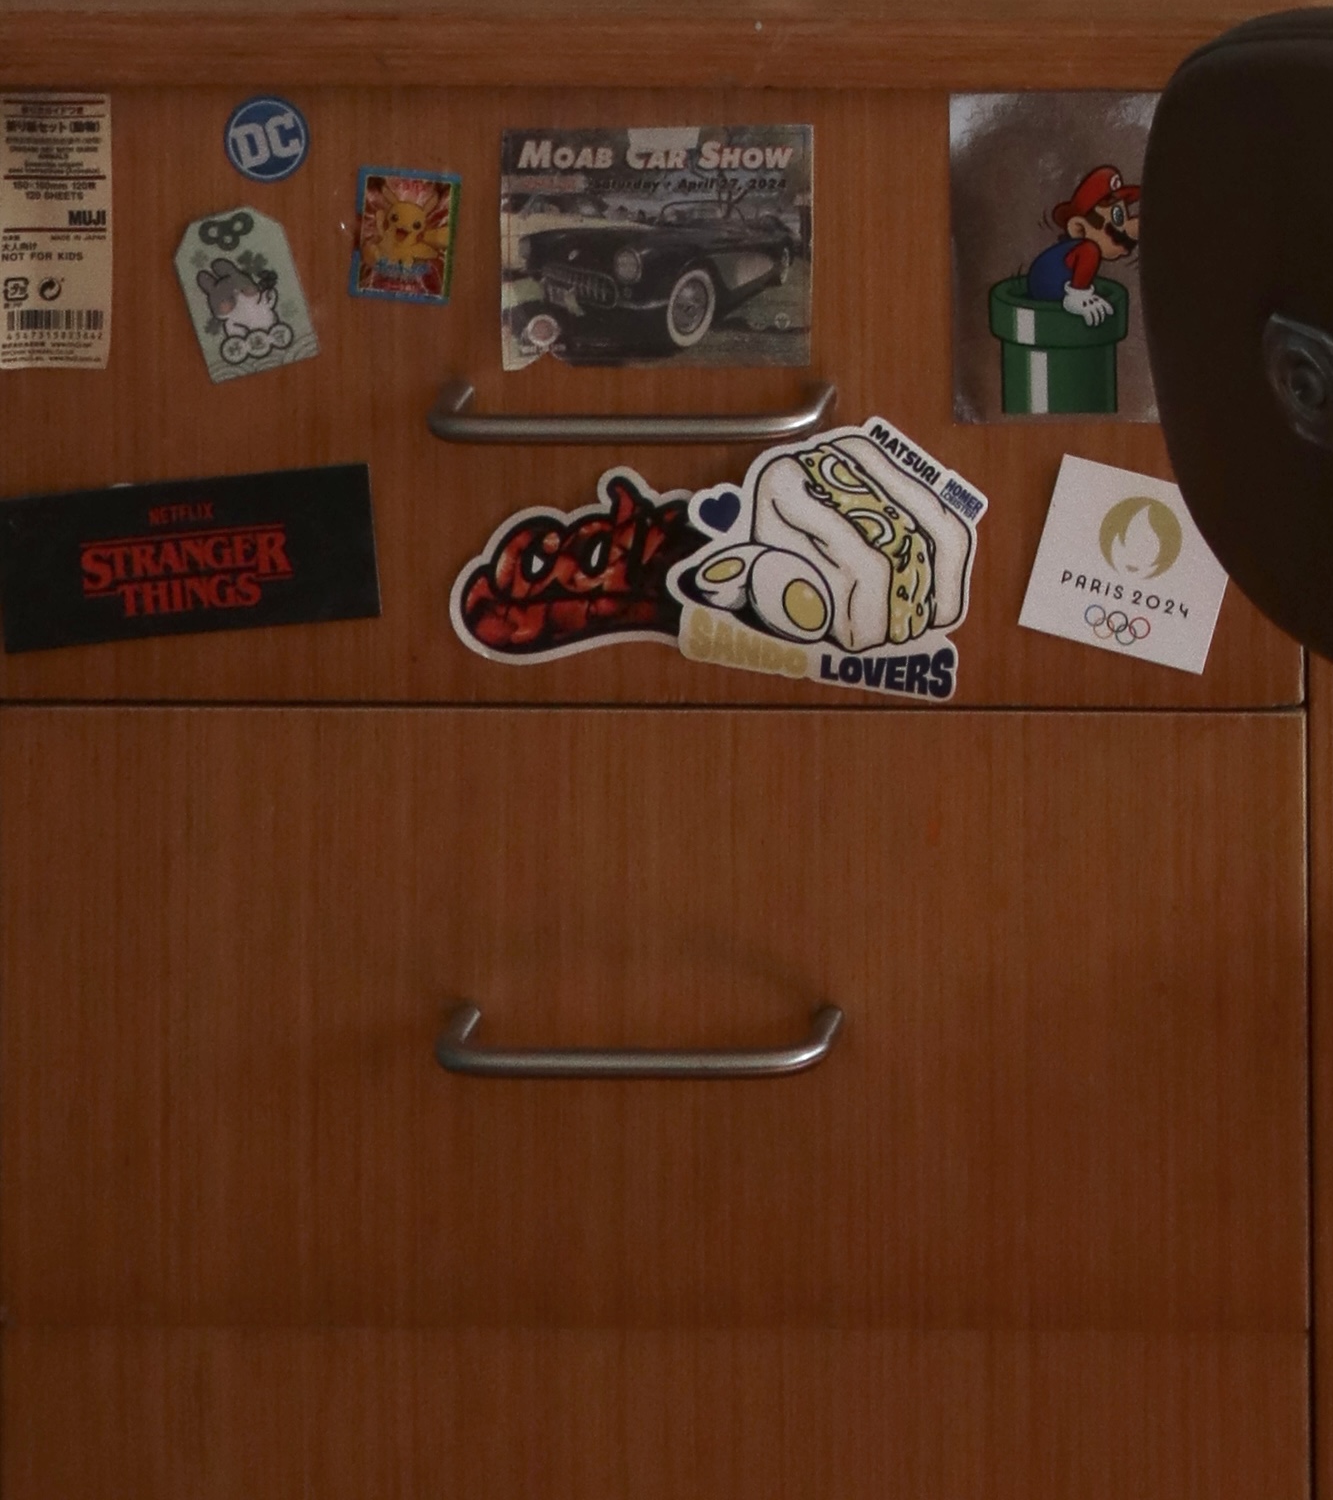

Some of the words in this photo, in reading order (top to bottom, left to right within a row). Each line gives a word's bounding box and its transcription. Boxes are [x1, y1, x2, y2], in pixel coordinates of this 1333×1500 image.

[229, 112, 303, 170] DC
[518, 139, 613, 169] MOAB
[625, 146, 687, 170] CAR
[698, 140, 793, 169] SHOW
[677, 177, 716, 192] April
[750, 178, 787, 190] 2024
[68, 210, 106, 226] MUJI
[1, 252, 25, 261] NOT
[30, 252, 53, 261] FOR
[57, 252, 83, 261] KIDS
[869, 424, 942, 486] MATSURI
[148, 502, 214, 525] NETFLIX
[945, 478, 984, 515] HOMER
[80, 530, 293, 591] STRANGER
[117, 571, 262, 618] THINGS
[1061, 569, 1124, 601] PARIS
[1132, 589, 1191, 619] 2024
[820, 647, 955, 699] LOVERS
